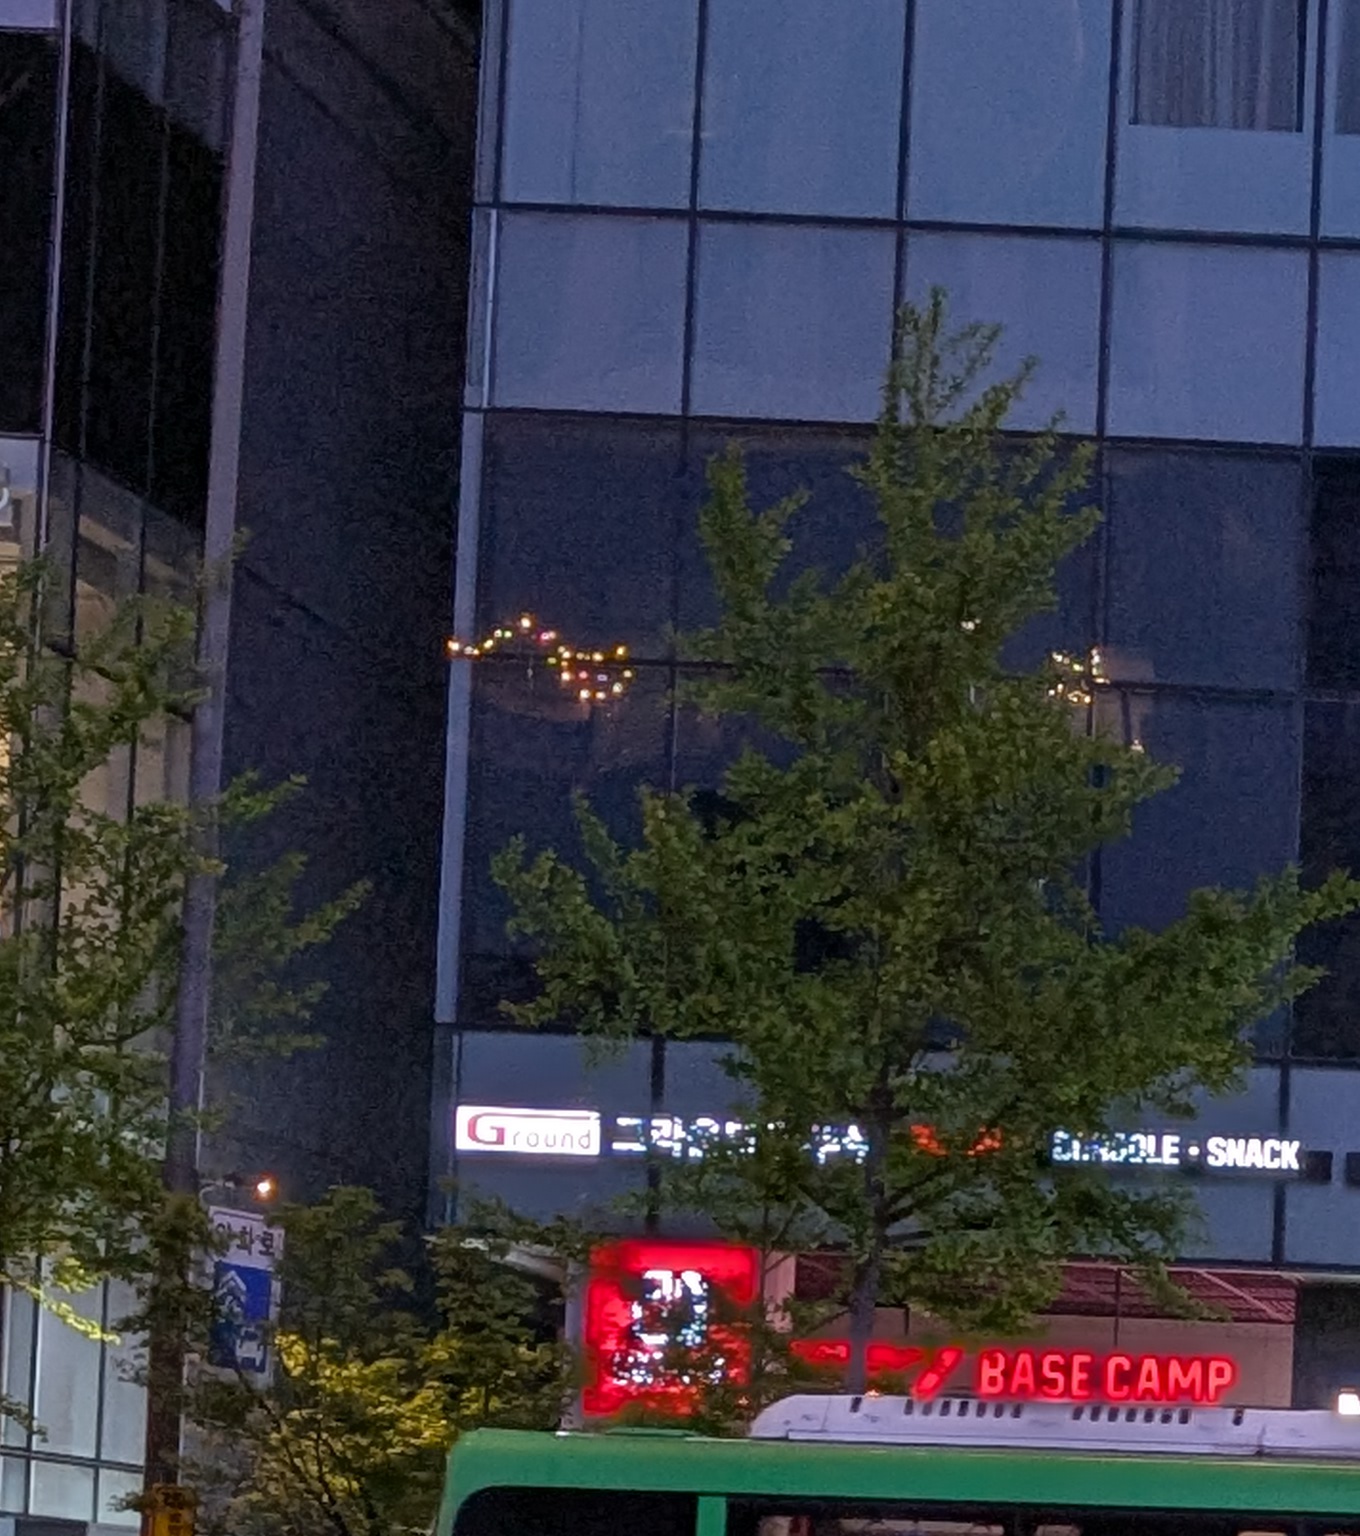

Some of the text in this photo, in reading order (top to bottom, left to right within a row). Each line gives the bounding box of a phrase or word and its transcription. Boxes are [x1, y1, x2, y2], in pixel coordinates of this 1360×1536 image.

[467, 1111, 592, 1150] Ground
[1207, 1136, 1301, 1170] SNACK
[979, 1351, 1234, 1403] BASE CAMP
